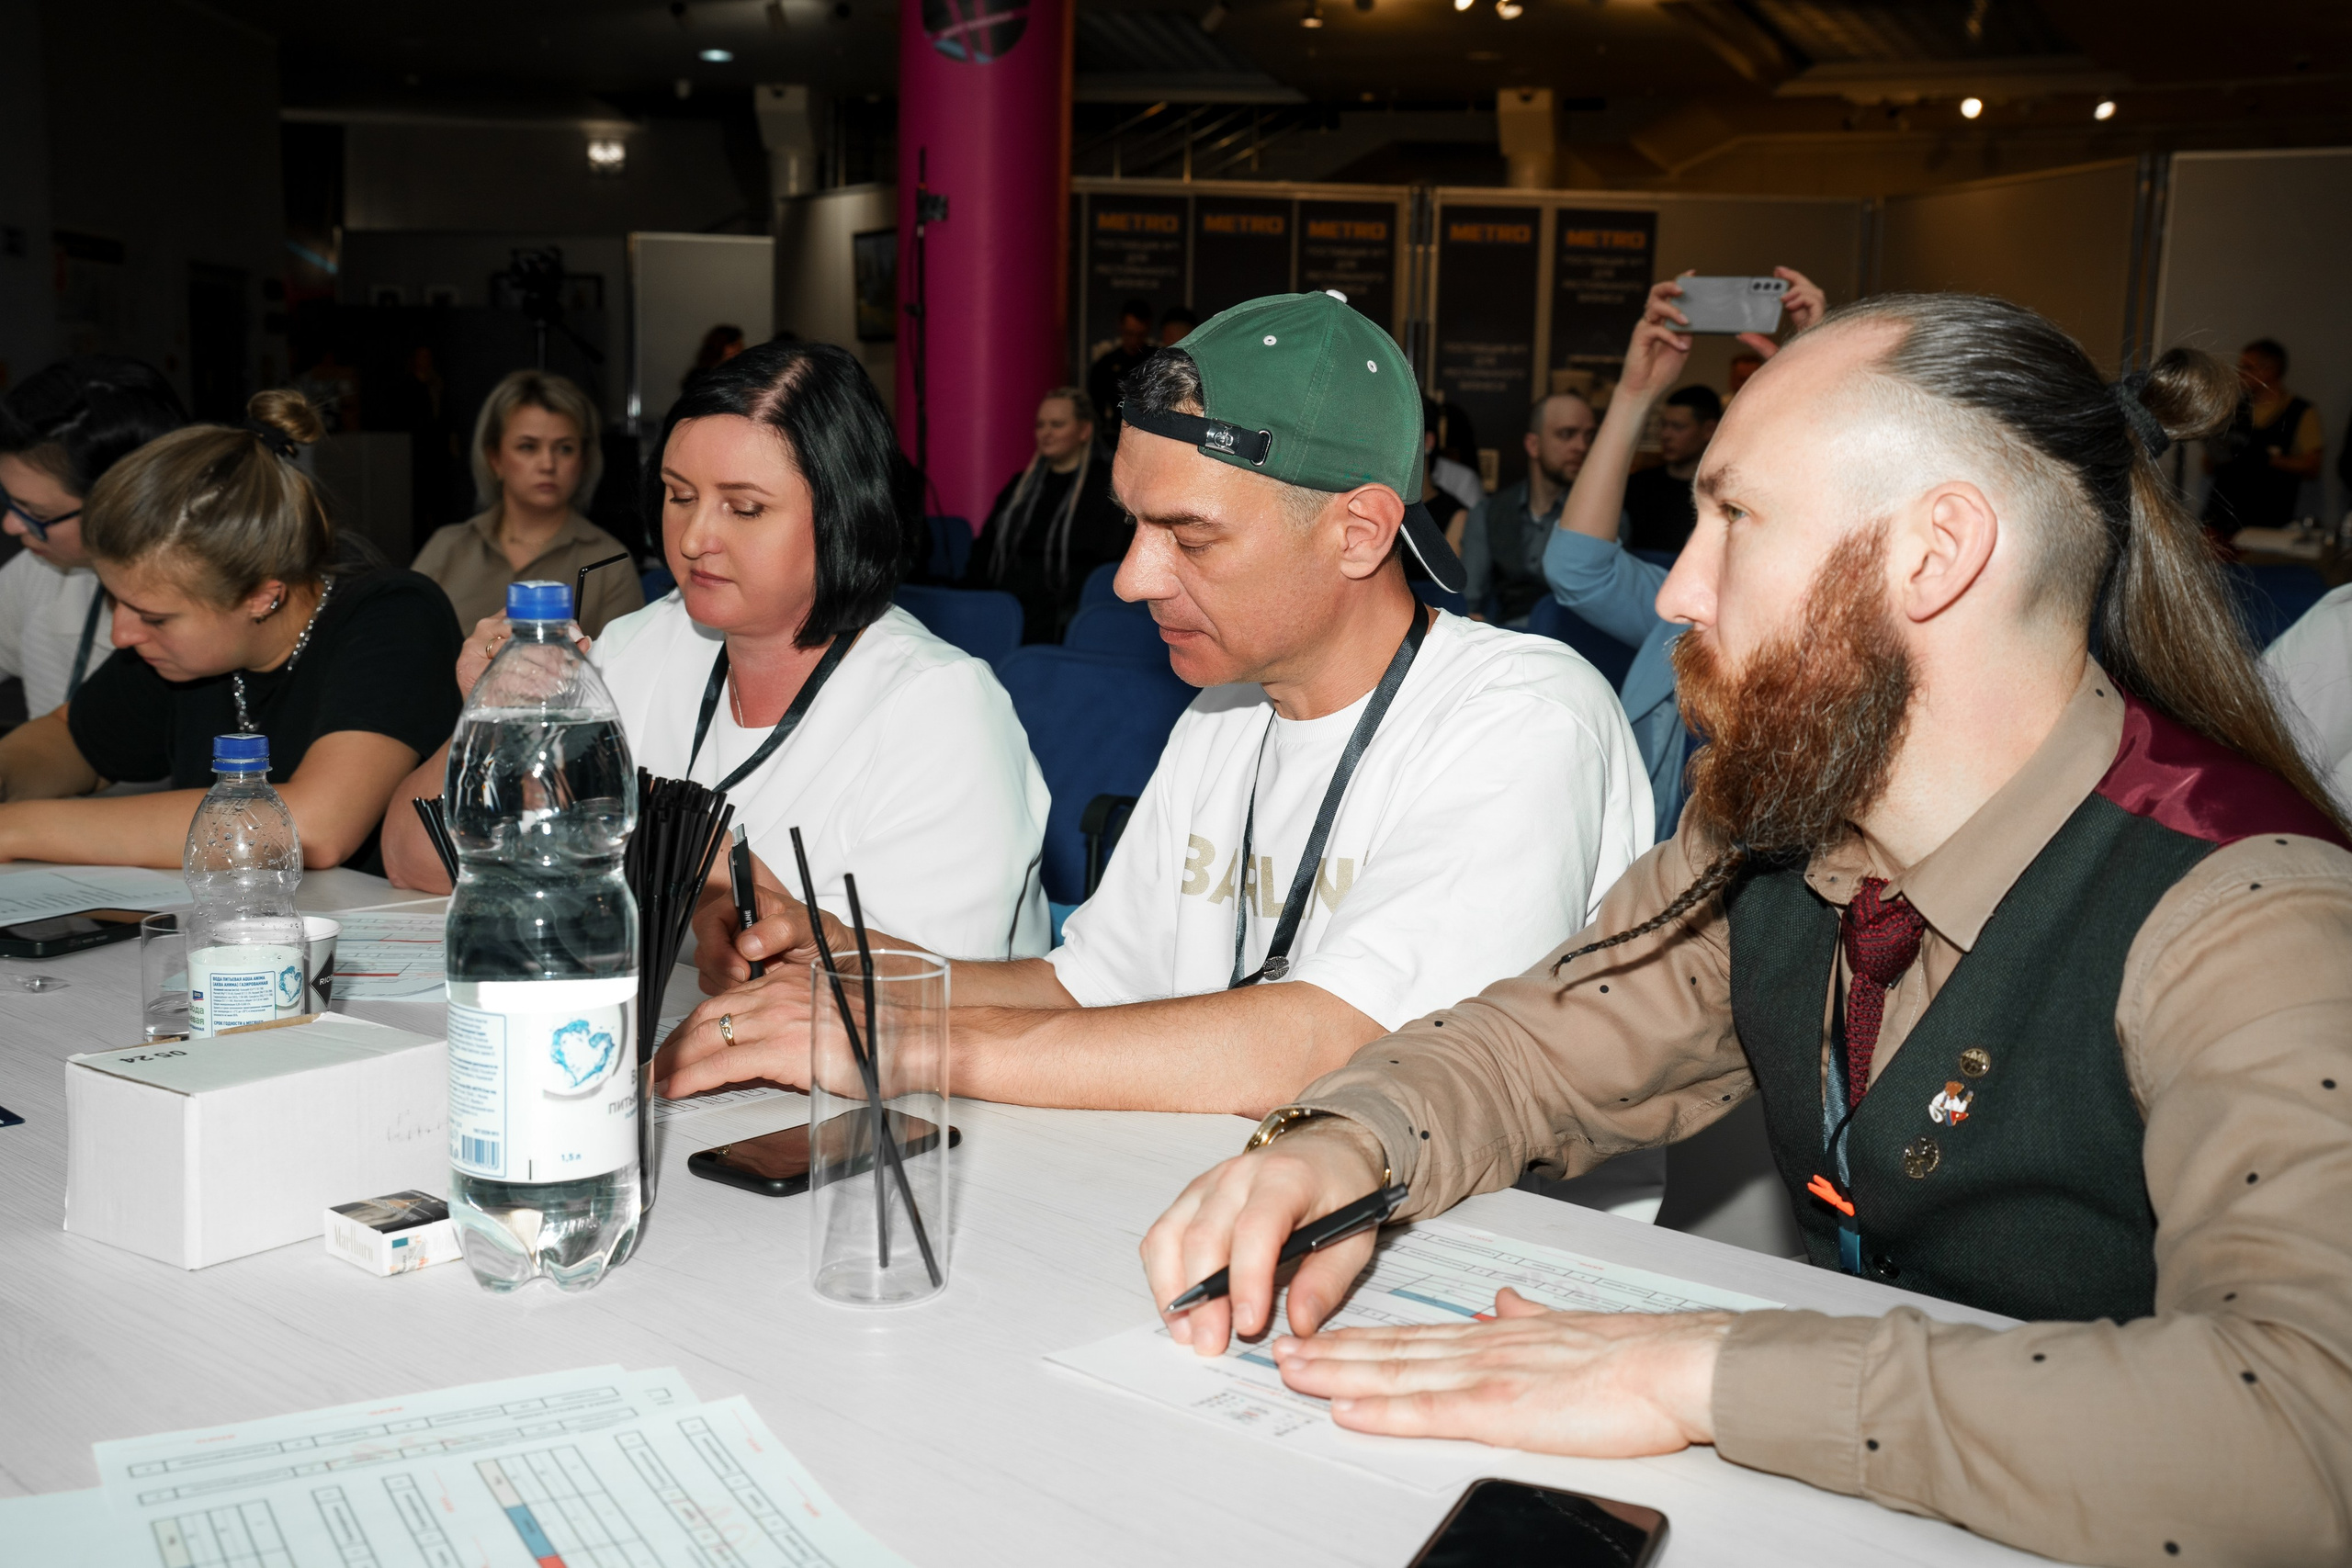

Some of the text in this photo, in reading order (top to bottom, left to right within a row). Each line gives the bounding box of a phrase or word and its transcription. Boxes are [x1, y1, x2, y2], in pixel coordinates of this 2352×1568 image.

[1096, 211, 1180, 234] METRO
[1203, 213, 1286, 236] METRO
[1306, 220, 1388, 242] METRO
[1449, 222, 1532, 244] METRO
[1564, 229, 1647, 250] METRO
[561, 1153, 573, 1162] 1,5
